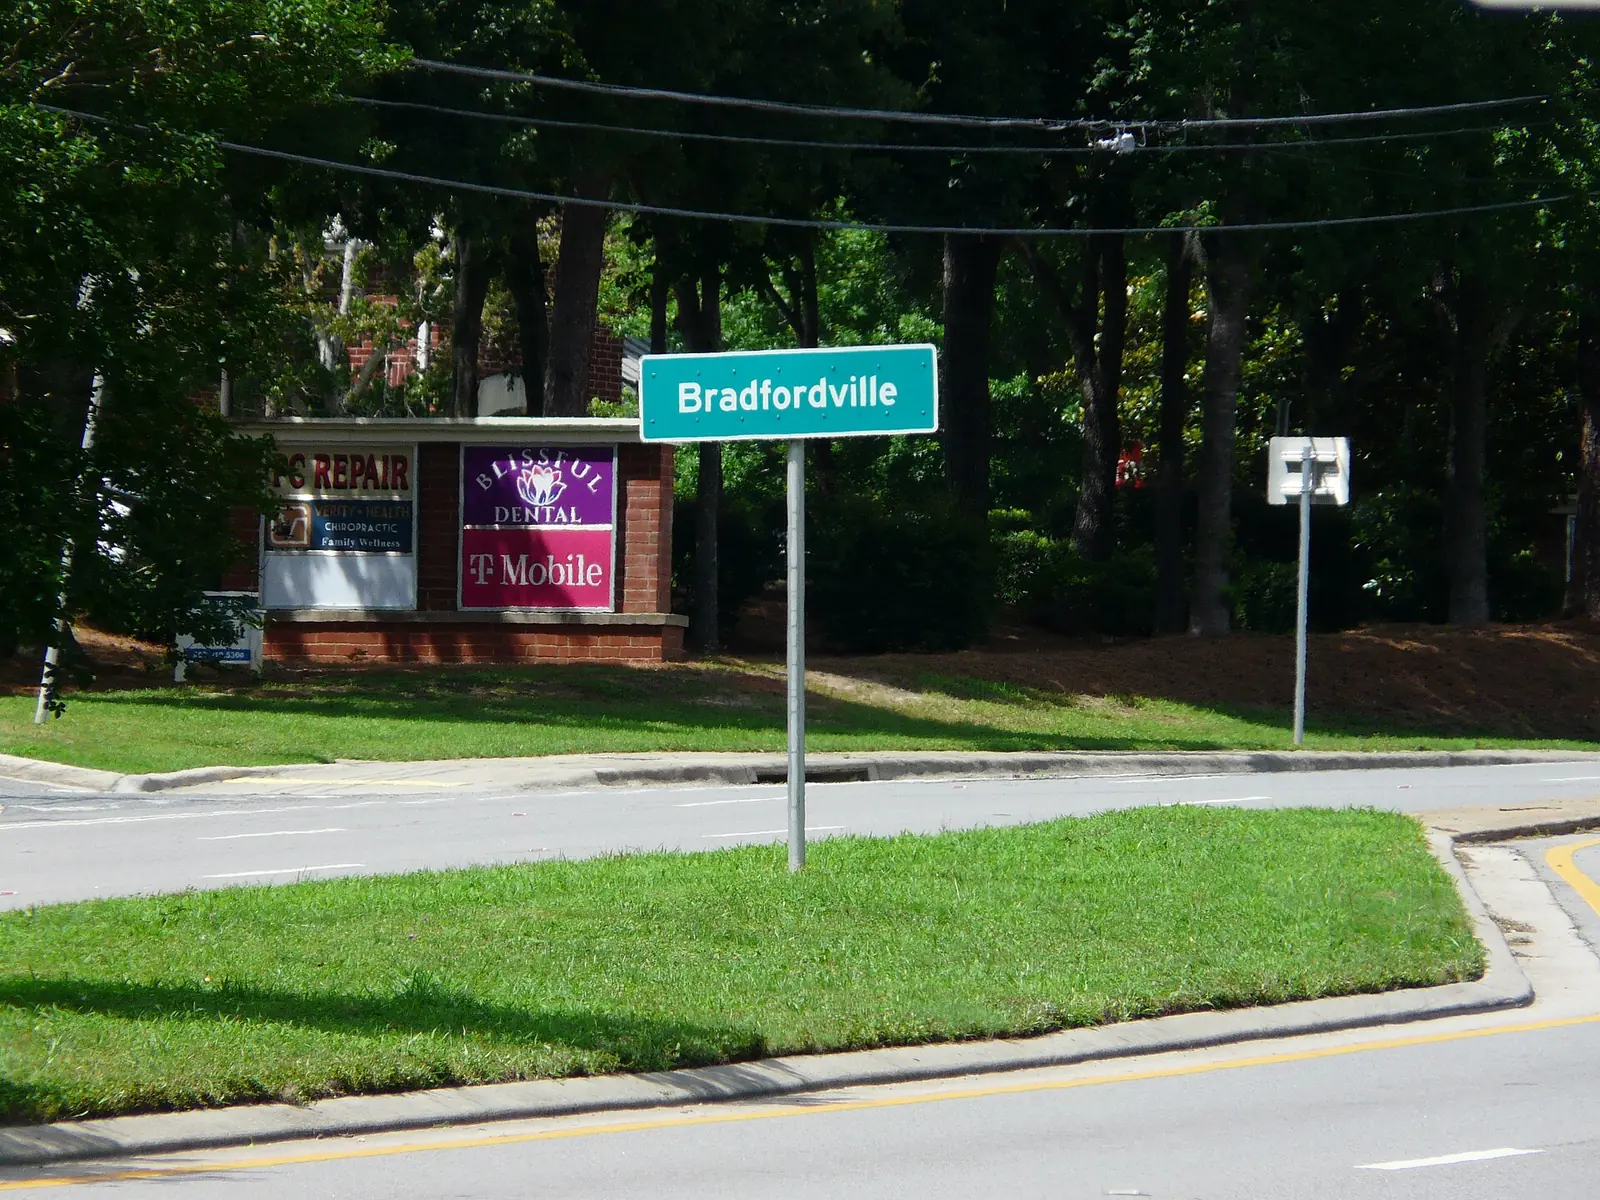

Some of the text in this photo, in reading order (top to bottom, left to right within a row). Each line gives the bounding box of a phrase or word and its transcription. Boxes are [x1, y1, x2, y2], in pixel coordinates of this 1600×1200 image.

[678, 375, 898, 414] Bradfordville
[314, 453, 409, 491] REPAIR
[476, 448, 603, 493] BLISSFUL
[314, 504, 410, 518] VERITY HEALTH
[495, 506, 582, 523] DENTAL
[324, 521, 399, 533] CHIROPRACTIC
[321, 537, 401, 548] Family Wellness
[500, 554, 603, 586] Mobile
